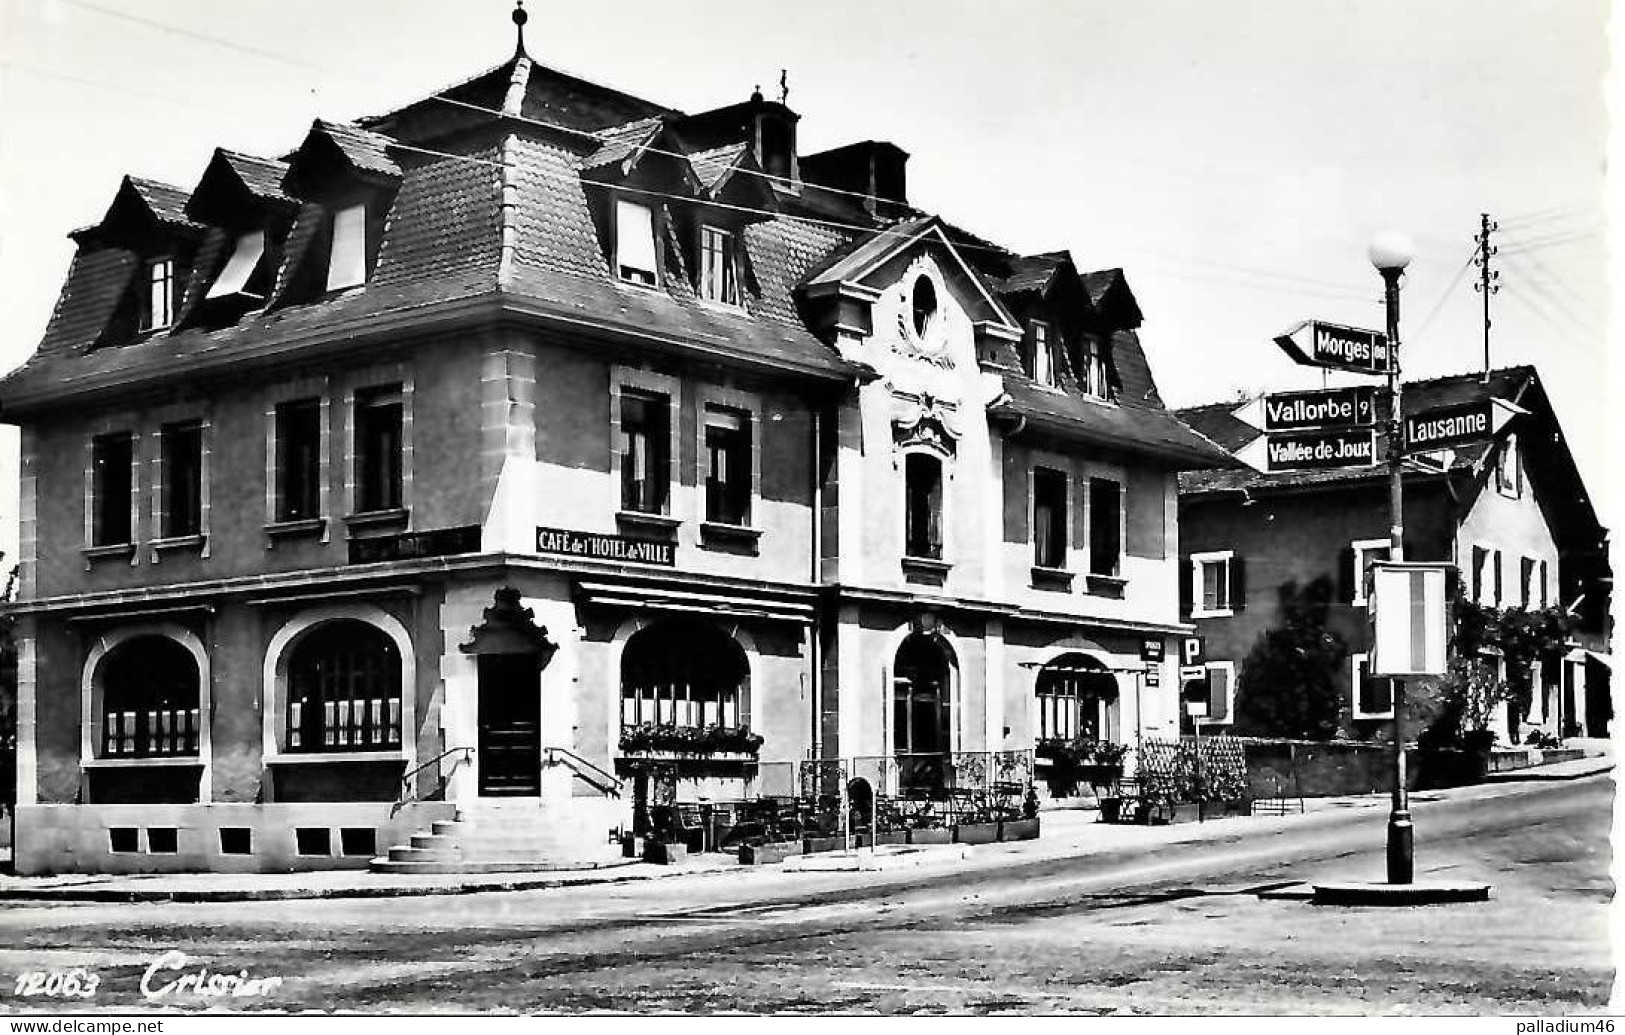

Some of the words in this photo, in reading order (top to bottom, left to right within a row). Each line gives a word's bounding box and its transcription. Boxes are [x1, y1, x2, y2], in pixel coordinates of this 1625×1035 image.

[1317, 329, 1370, 362] Morges
[1267, 398, 1352, 422] Vallorbe
[1359, 401, 1369, 416] 9
[1408, 413, 1486, 443] Lausanne
[1268, 441, 1313, 463] Vallée
[1314, 440, 1333, 460] de
[1334, 438, 1371, 459] Joux
[539, 530, 571, 552] CAFÉ
[637, 542, 670, 563] VILLE
[1185, 638, 1200, 665] P
